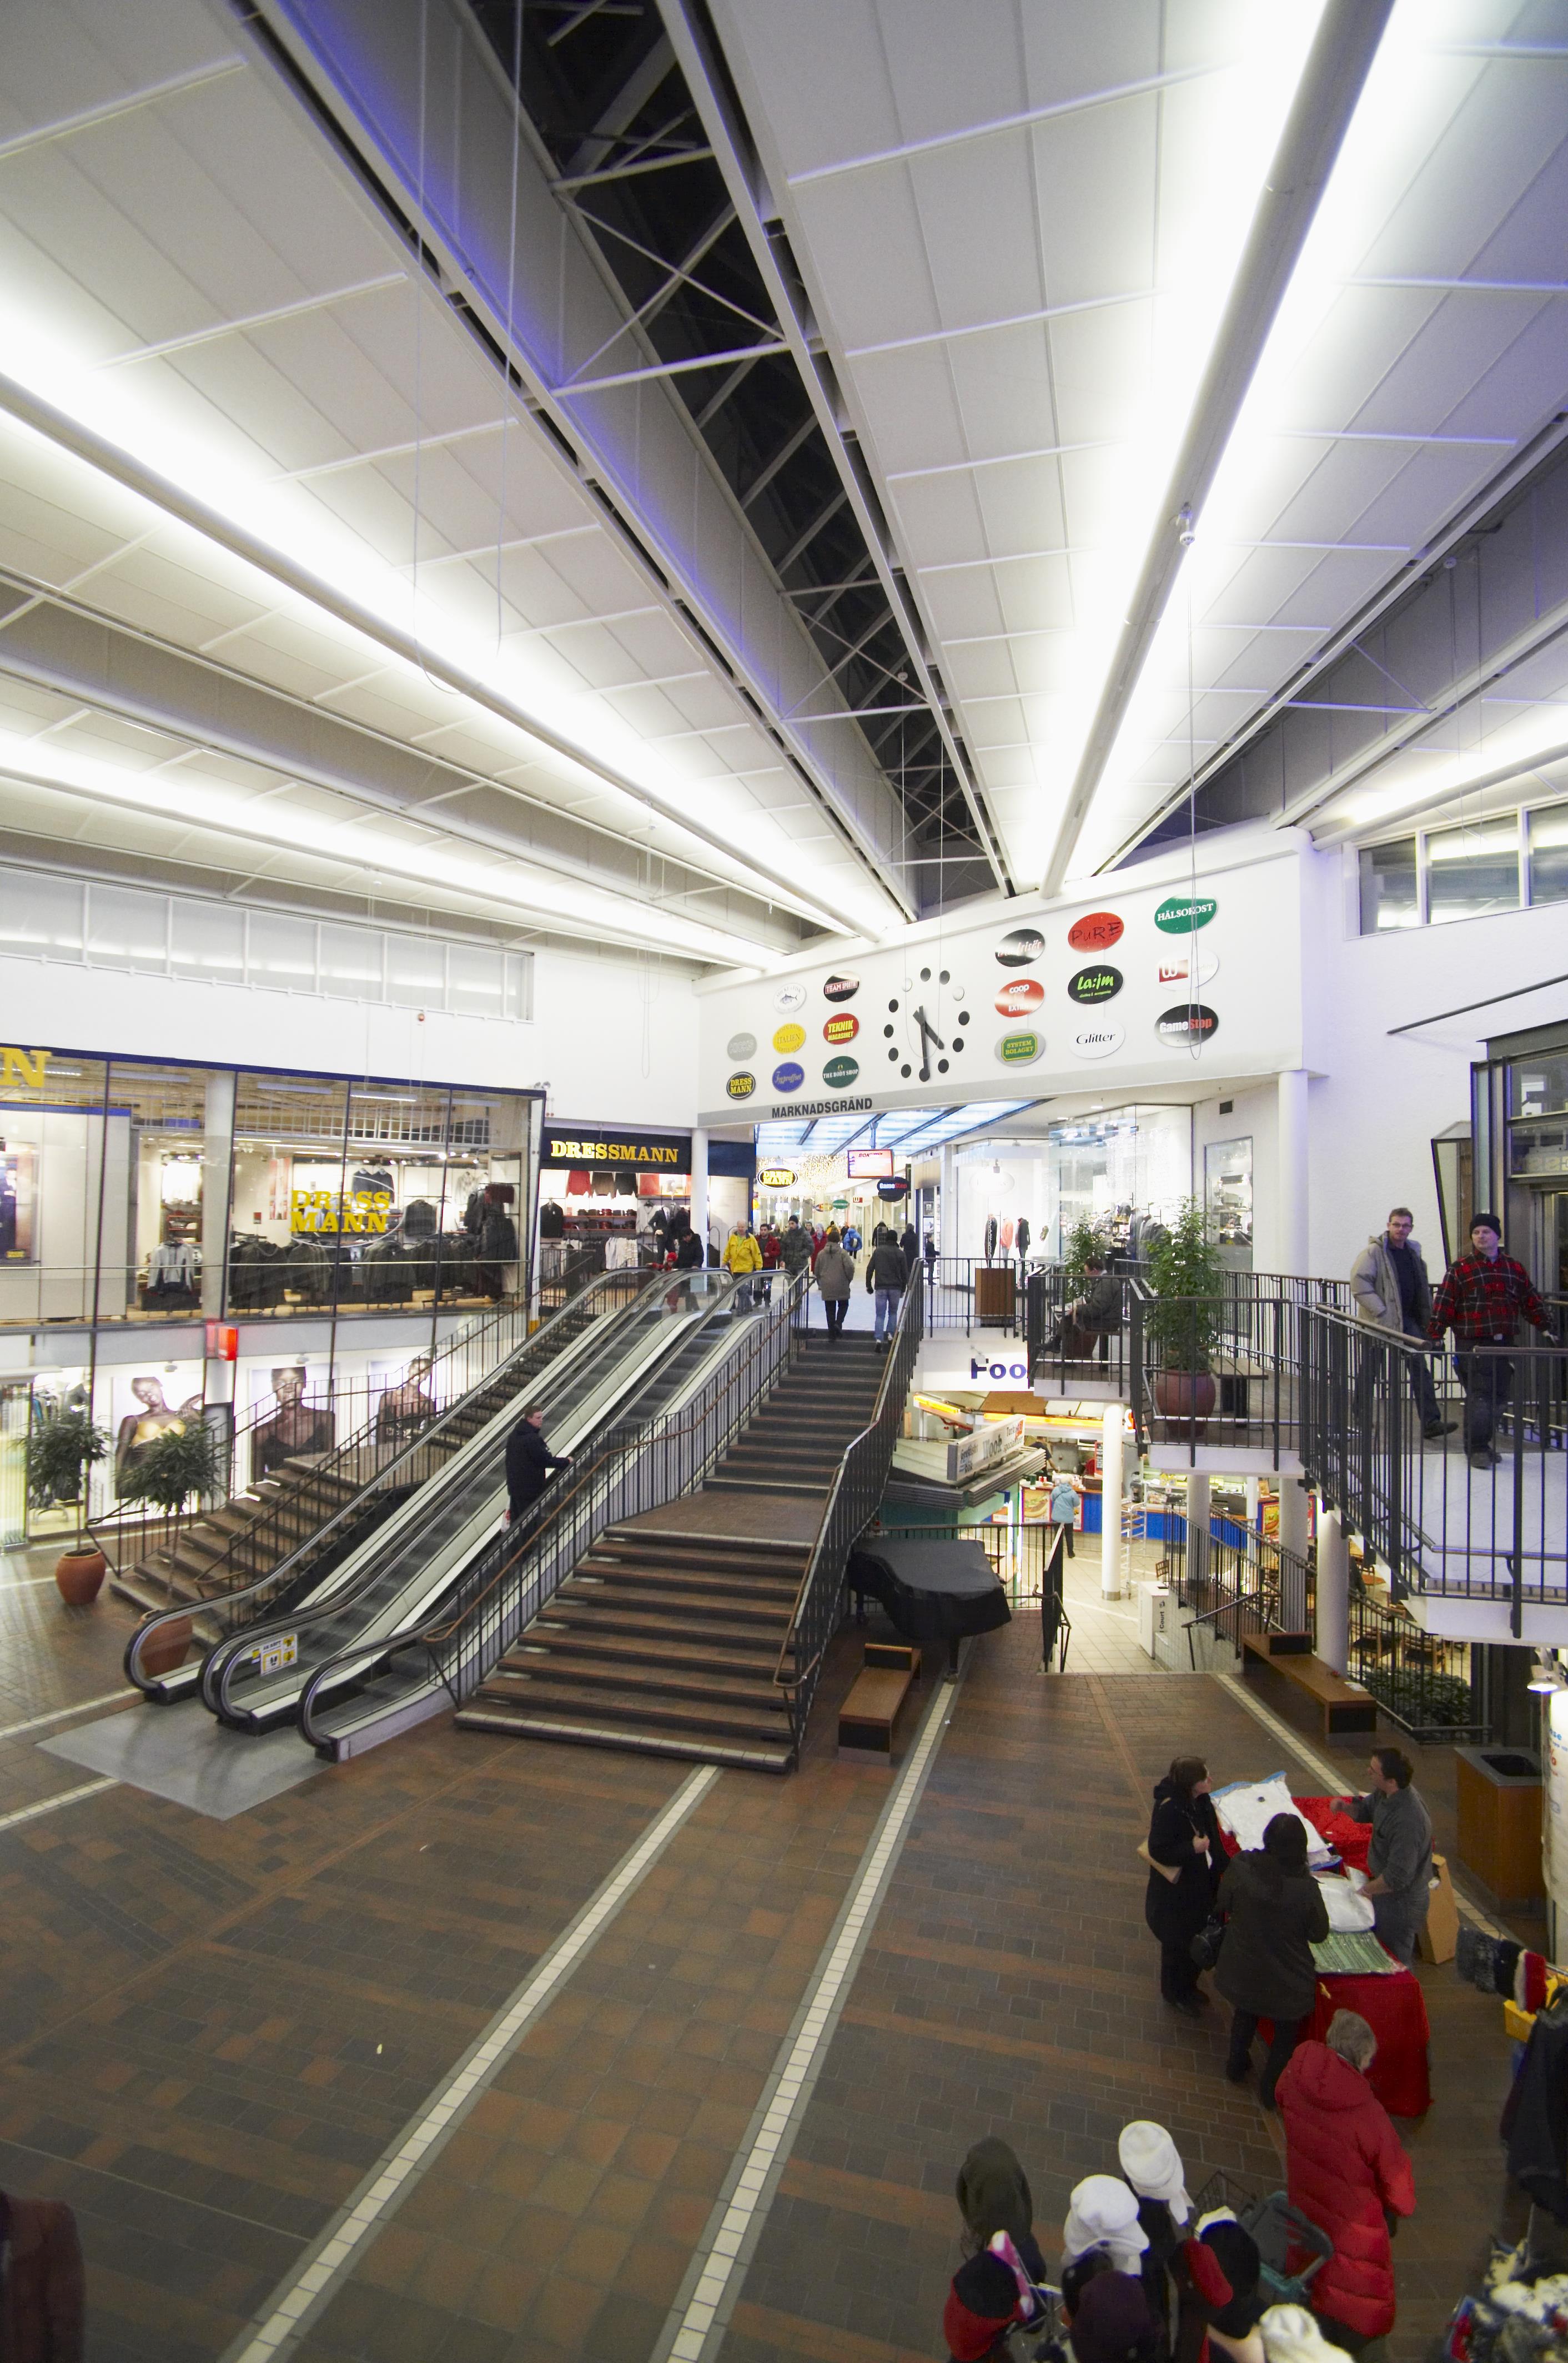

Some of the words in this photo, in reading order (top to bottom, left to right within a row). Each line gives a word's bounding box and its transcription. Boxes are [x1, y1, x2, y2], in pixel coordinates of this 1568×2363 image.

[1157, 903, 1214, 921] HÄLSOKOST
[826, 983, 841, 993] TEAM
[827, 1020, 854, 1033] TEKNIK
[1159, 1018, 1212, 1033] GameStop
[777, 1033, 801, 1044] ITALIEN
[827, 1031, 854, 1041] MAGASINET
[1076, 1033, 1116, 1044] Glitter
[1007, 1039, 1032, 1048] SYSTEM
[1005, 1046, 1034, 1055] BOLAGET
[731, 1077, 752, 1087] DRESS
[730, 1084, 752, 1094] MANN
[772, 1095, 872, 1118] MARKNADSGRÄND
[551, 1140, 679, 1163] DRESSMANN
[763, 1177, 793, 1185] MANN
[290, 1190, 391, 1210] DRESS
[289, 1211, 389, 1233] MANN
[971, 1358, 1028, 1379] Foo
